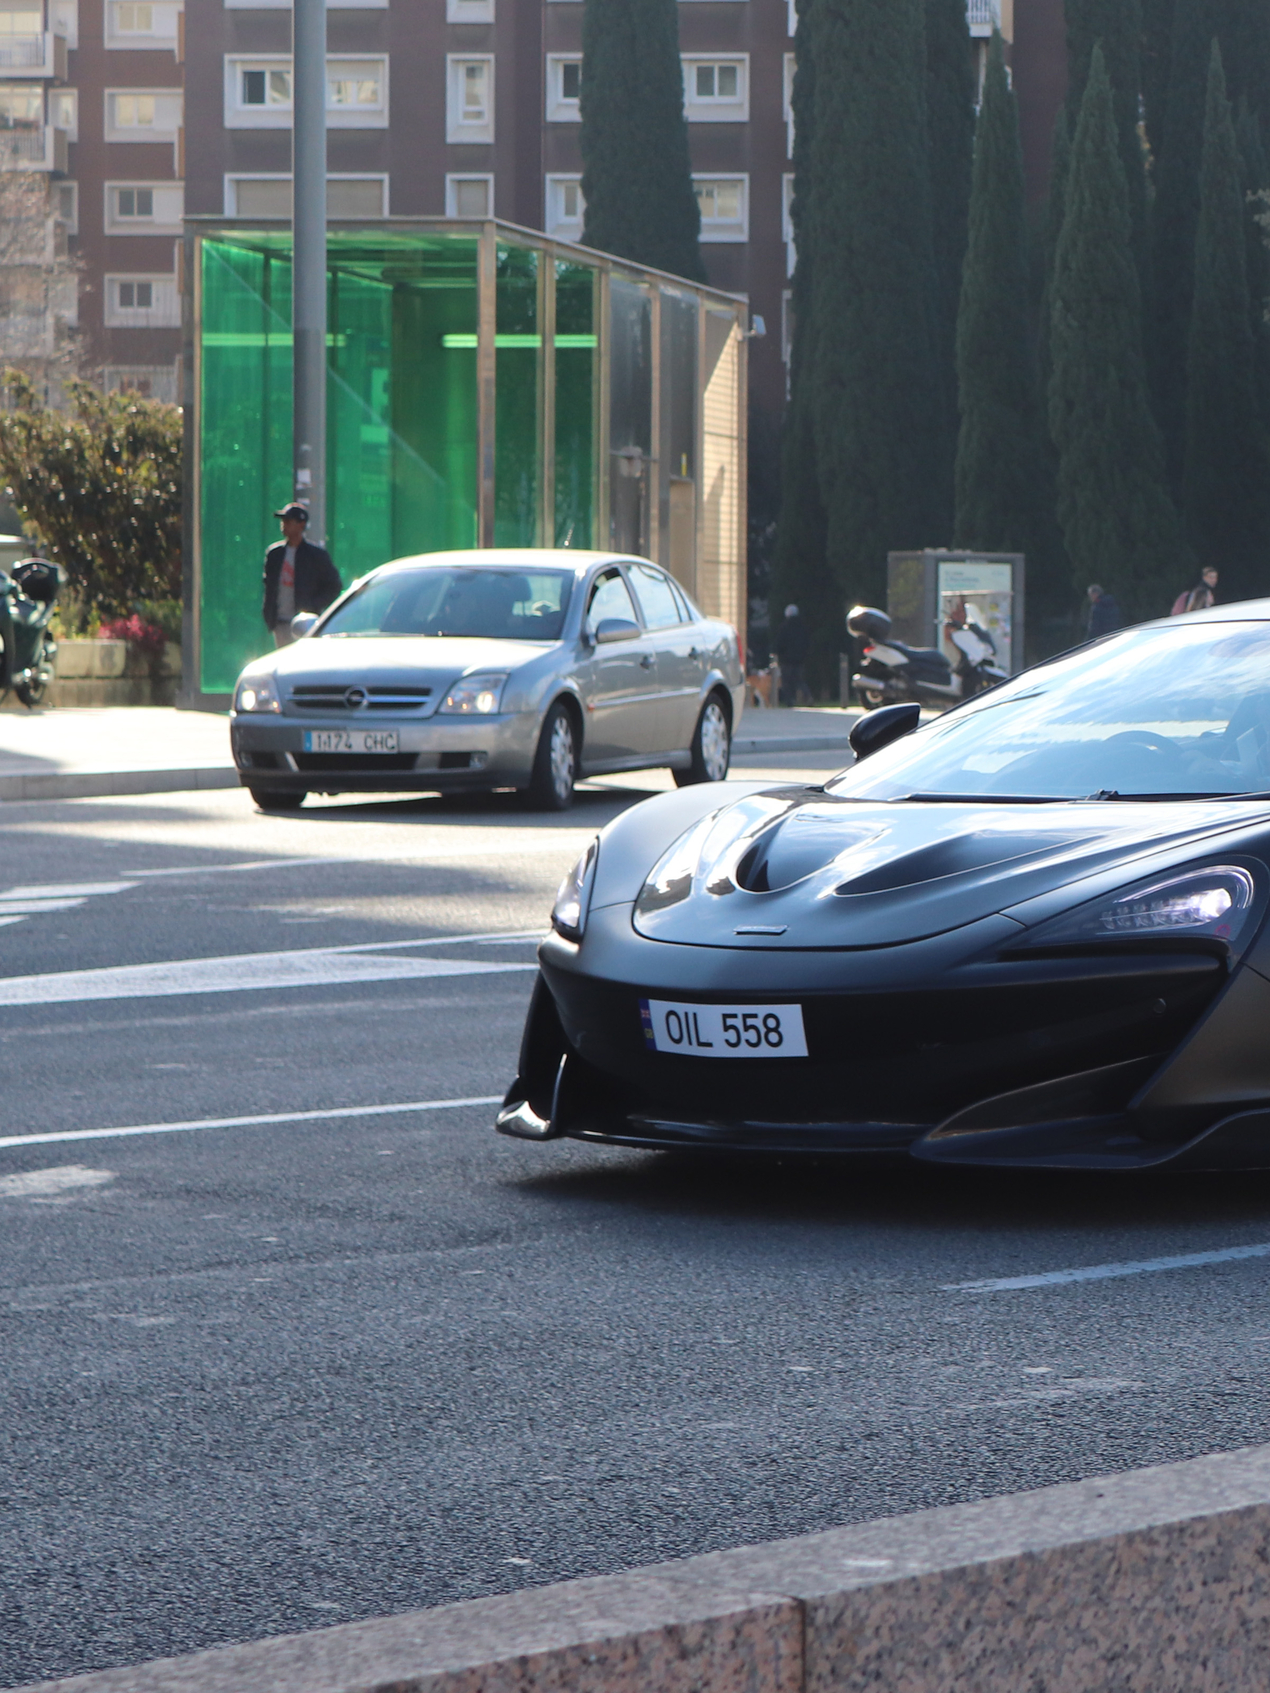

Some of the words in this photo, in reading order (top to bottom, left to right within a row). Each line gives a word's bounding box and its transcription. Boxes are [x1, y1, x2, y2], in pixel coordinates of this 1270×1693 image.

[317, 733, 353, 750] 1174
[363, 733, 396, 751] CHC
[665, 1009, 713, 1048] OIL
[721, 1012, 784, 1048] 558
